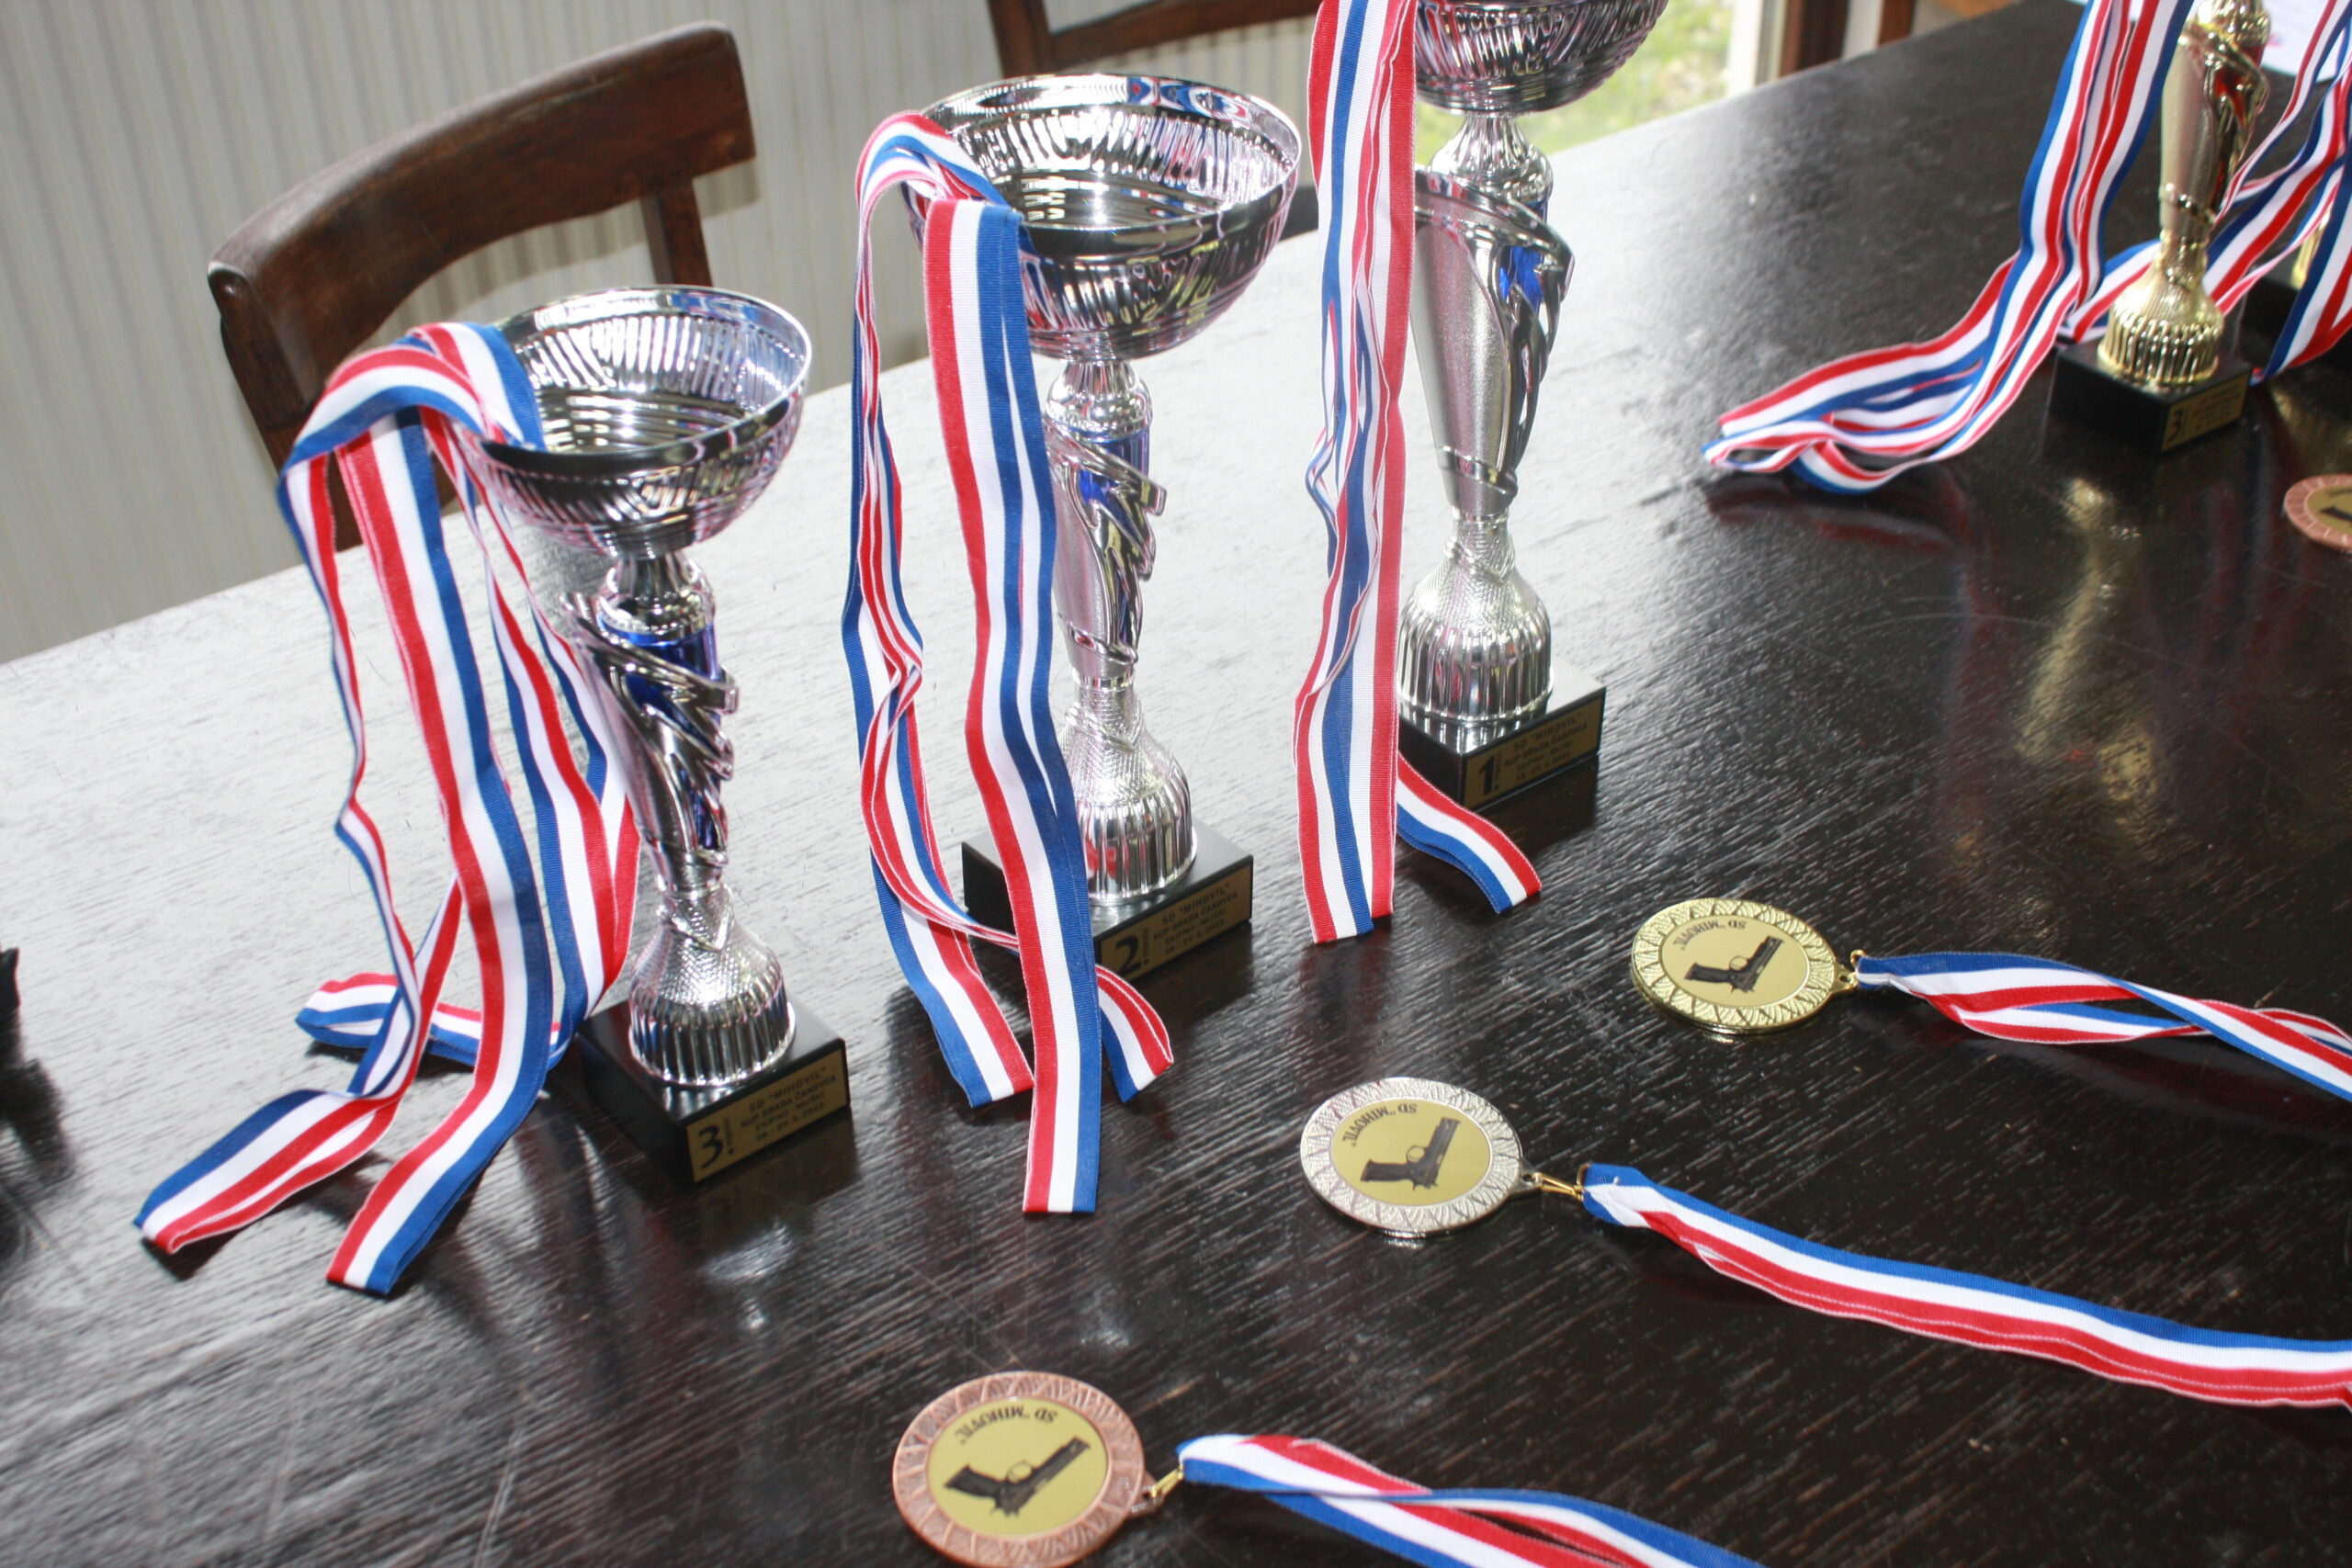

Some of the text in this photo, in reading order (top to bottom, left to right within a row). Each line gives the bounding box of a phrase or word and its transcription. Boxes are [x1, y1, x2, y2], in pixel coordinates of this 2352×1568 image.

[1728, 919, 1747, 930] SD
[1342, 1103, 1418, 1147] SD "MIHOVIL"
[1035, 1407, 1057, 1423] SD
